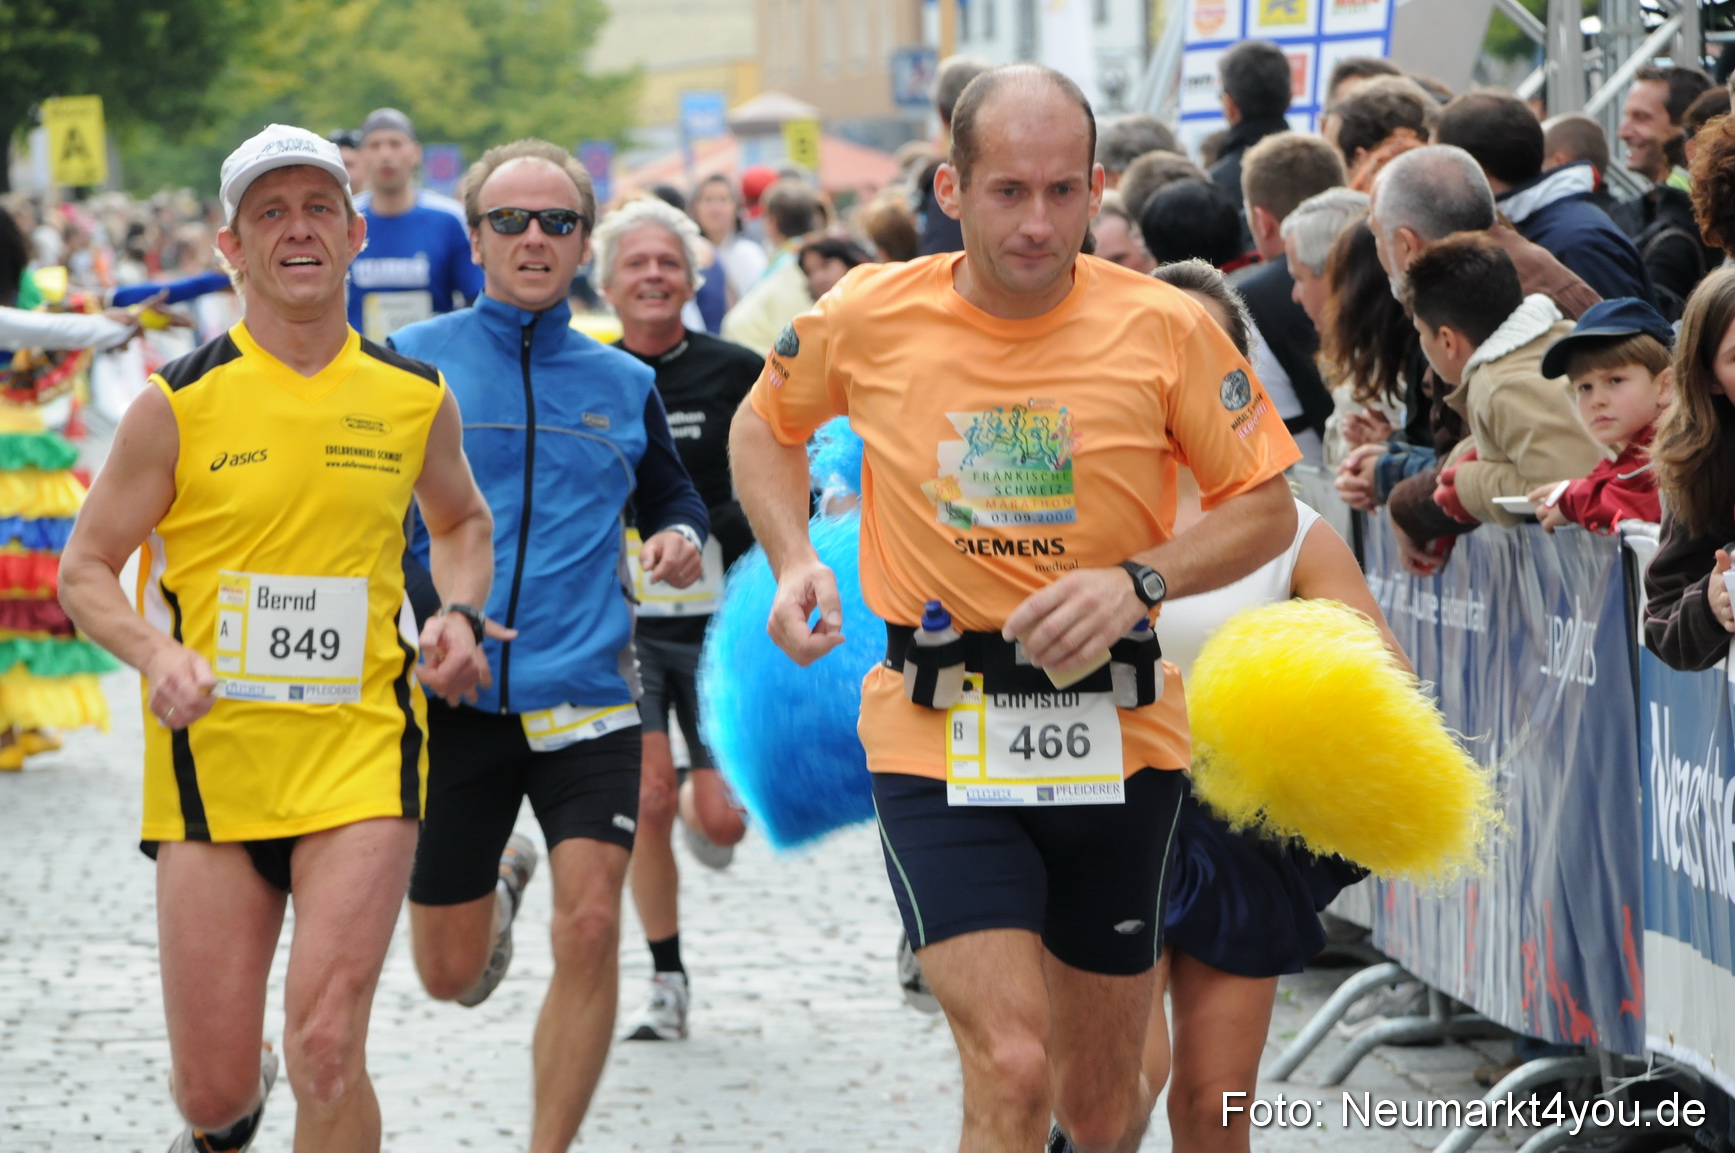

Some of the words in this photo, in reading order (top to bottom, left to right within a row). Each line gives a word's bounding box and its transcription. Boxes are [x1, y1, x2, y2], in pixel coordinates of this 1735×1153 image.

[61, 127, 93, 161] A
[972, 468, 1069, 483] FRÄNKISCHE
[994, 484, 1063, 496] SCHWEIZ
[985, 497, 1073, 510] MARATHON
[991, 512, 1074, 525] 03.09.2006
[955, 537, 1066, 557] SIEMENS
[1034, 559, 1079, 573] medical
[257, 585, 317, 612] Bernd
[220, 618, 229, 638] A
[269, 626, 341, 662] 849
[953, 721, 964, 741] B
[1009, 722, 1091, 761] 466
[1055, 783, 1121, 796] PFLEIDERER
